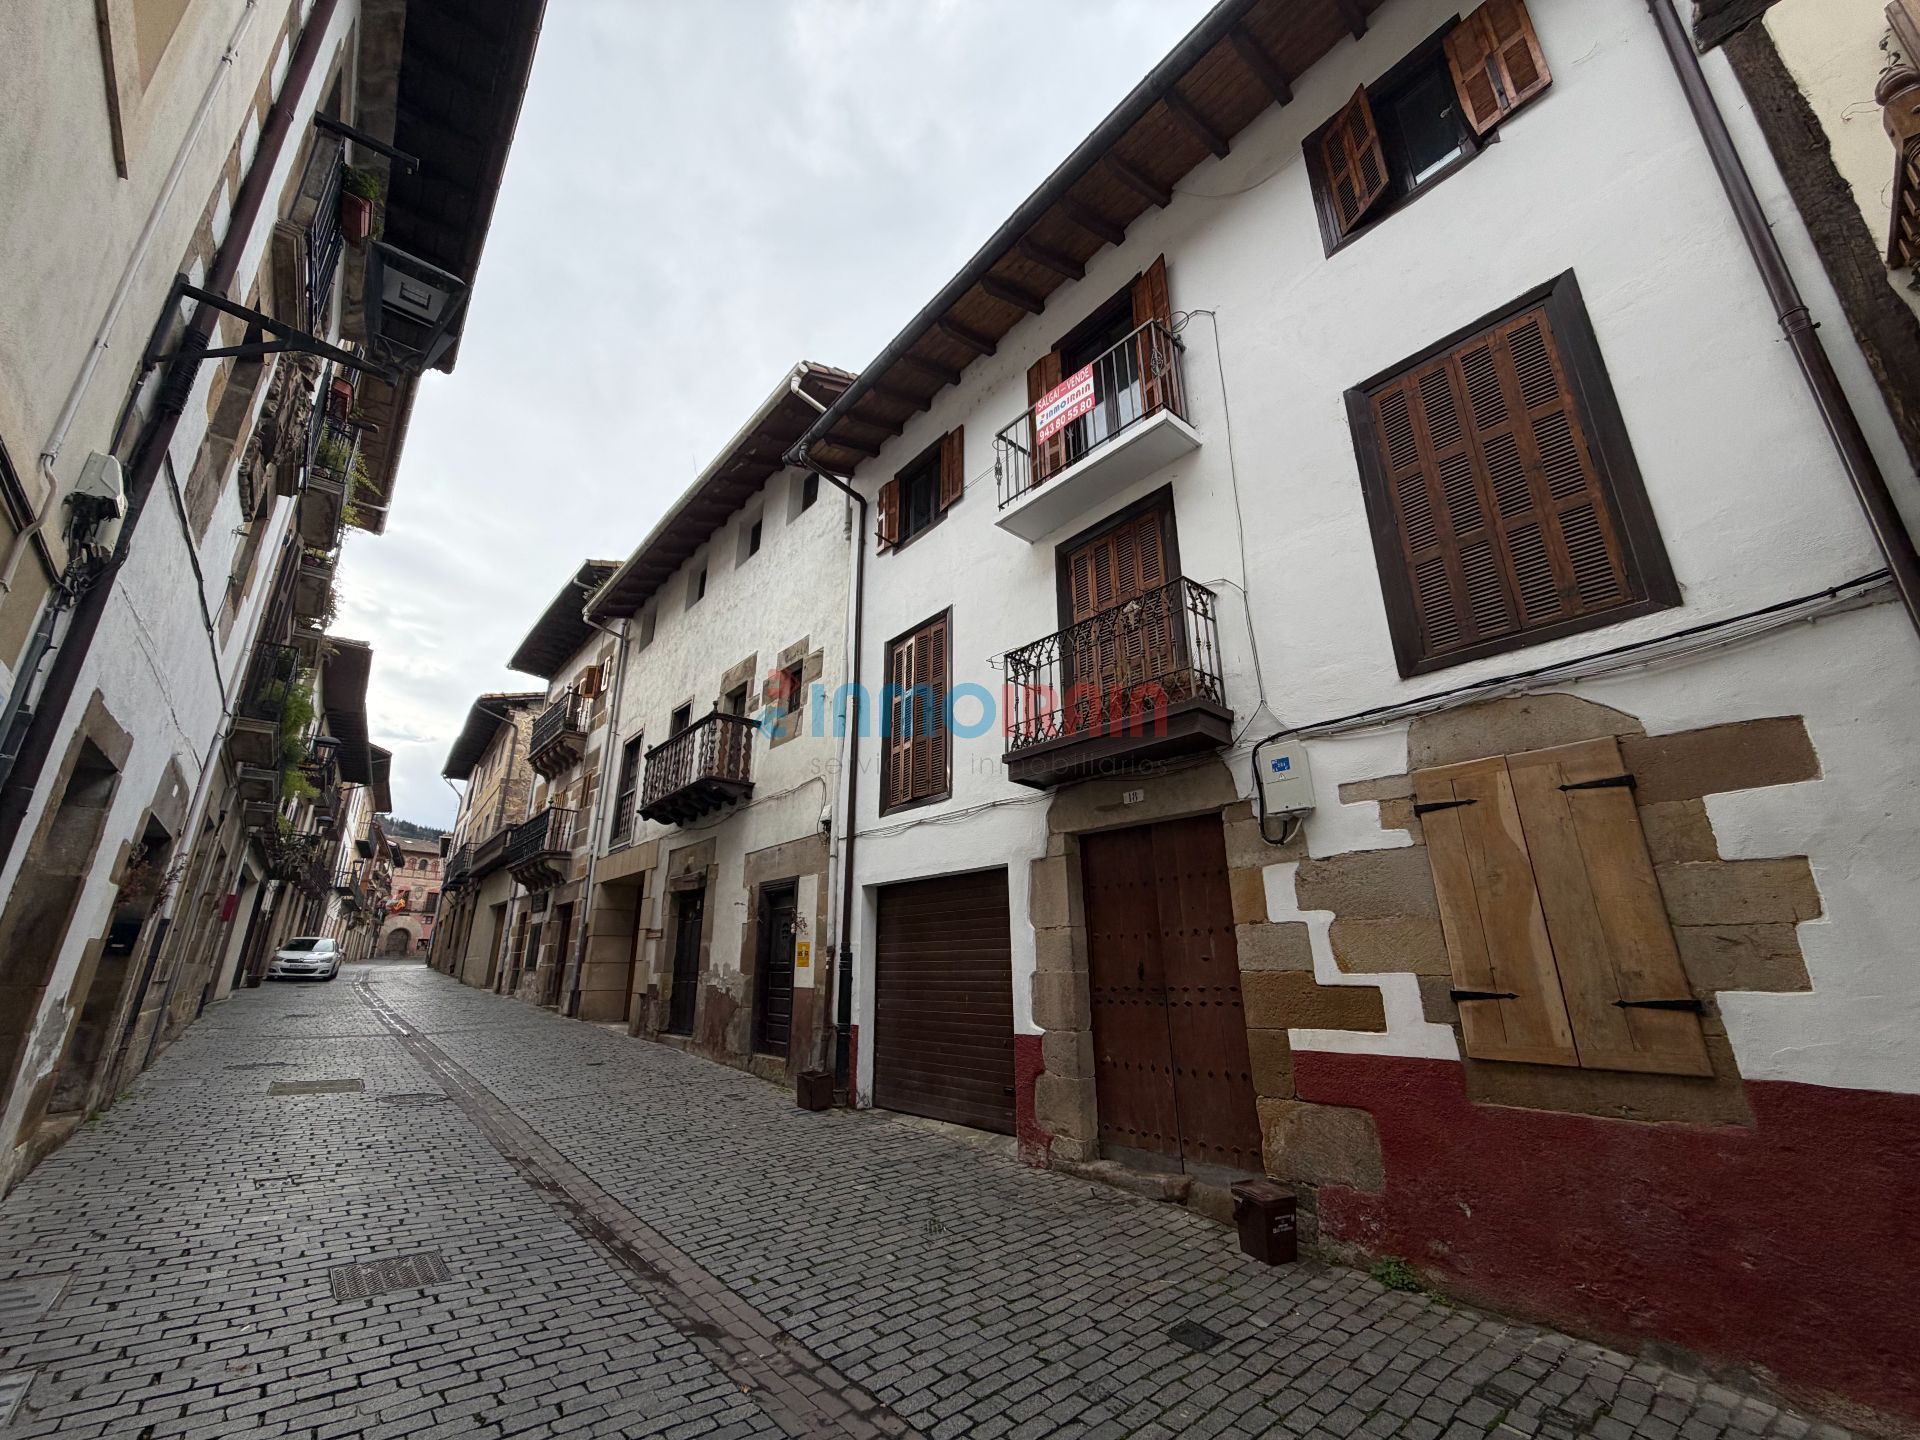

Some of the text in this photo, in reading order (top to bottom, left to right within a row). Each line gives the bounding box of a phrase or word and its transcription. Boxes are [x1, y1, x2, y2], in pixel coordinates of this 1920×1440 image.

[1038, 388, 1060, 411] SALGAI
[1066, 367, 1090, 389] VENDE
[1039, 398, 1092, 441] 943 80 55 80
[1128, 791, 1138, 802] 18
